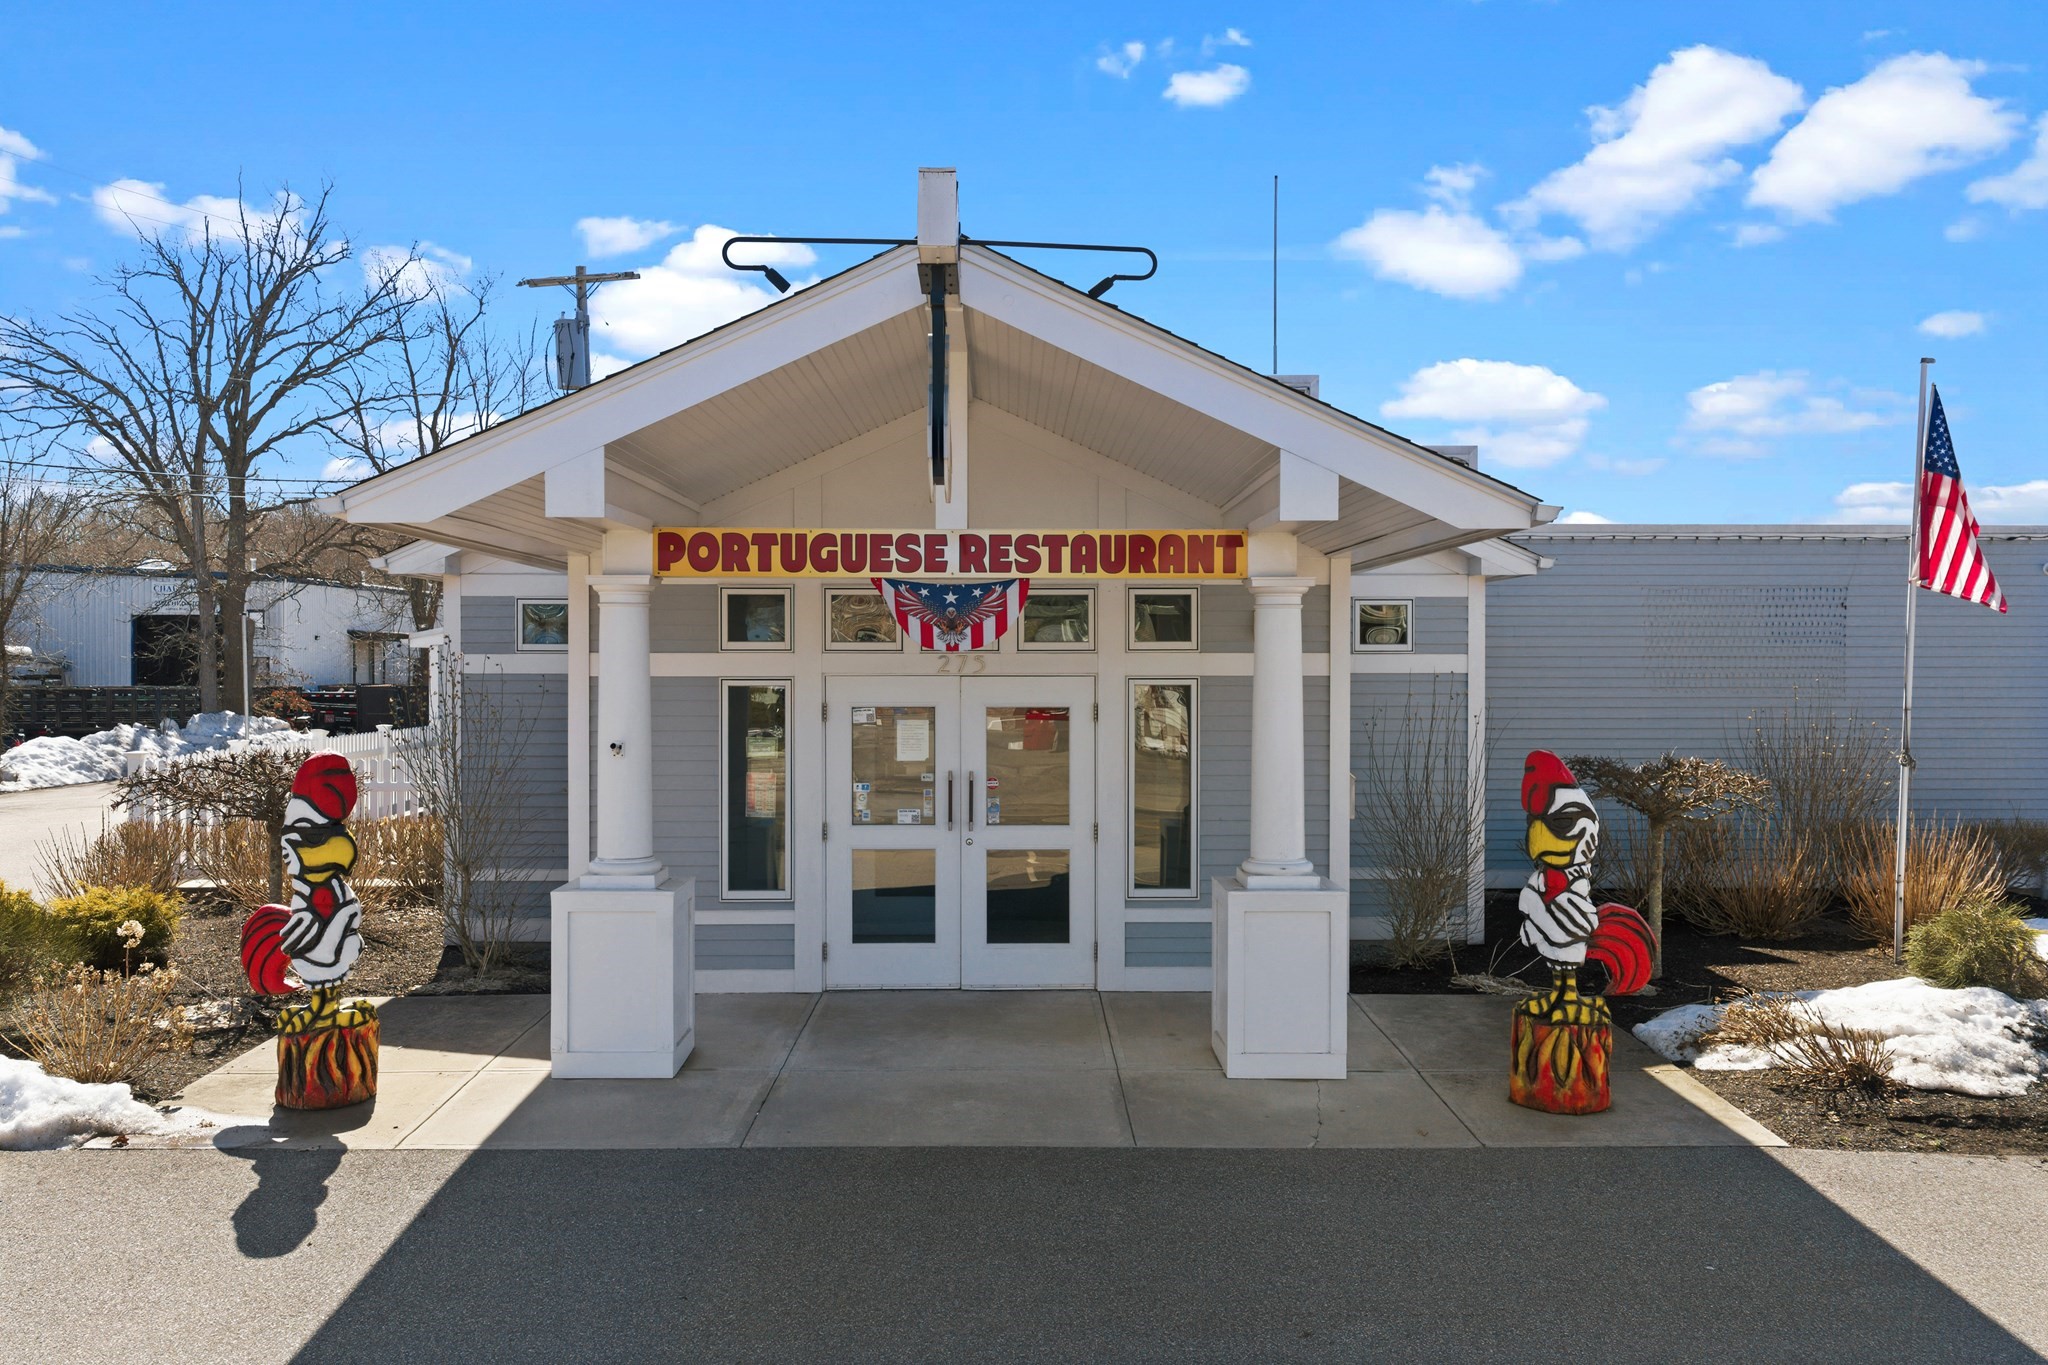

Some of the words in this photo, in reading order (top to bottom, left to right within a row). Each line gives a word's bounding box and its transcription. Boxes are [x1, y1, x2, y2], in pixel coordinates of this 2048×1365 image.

[657, 532, 948, 573] PORTUGUESE
[959, 533, 1244, 574] RESTAURANT
[937, 655, 986, 674] 275
